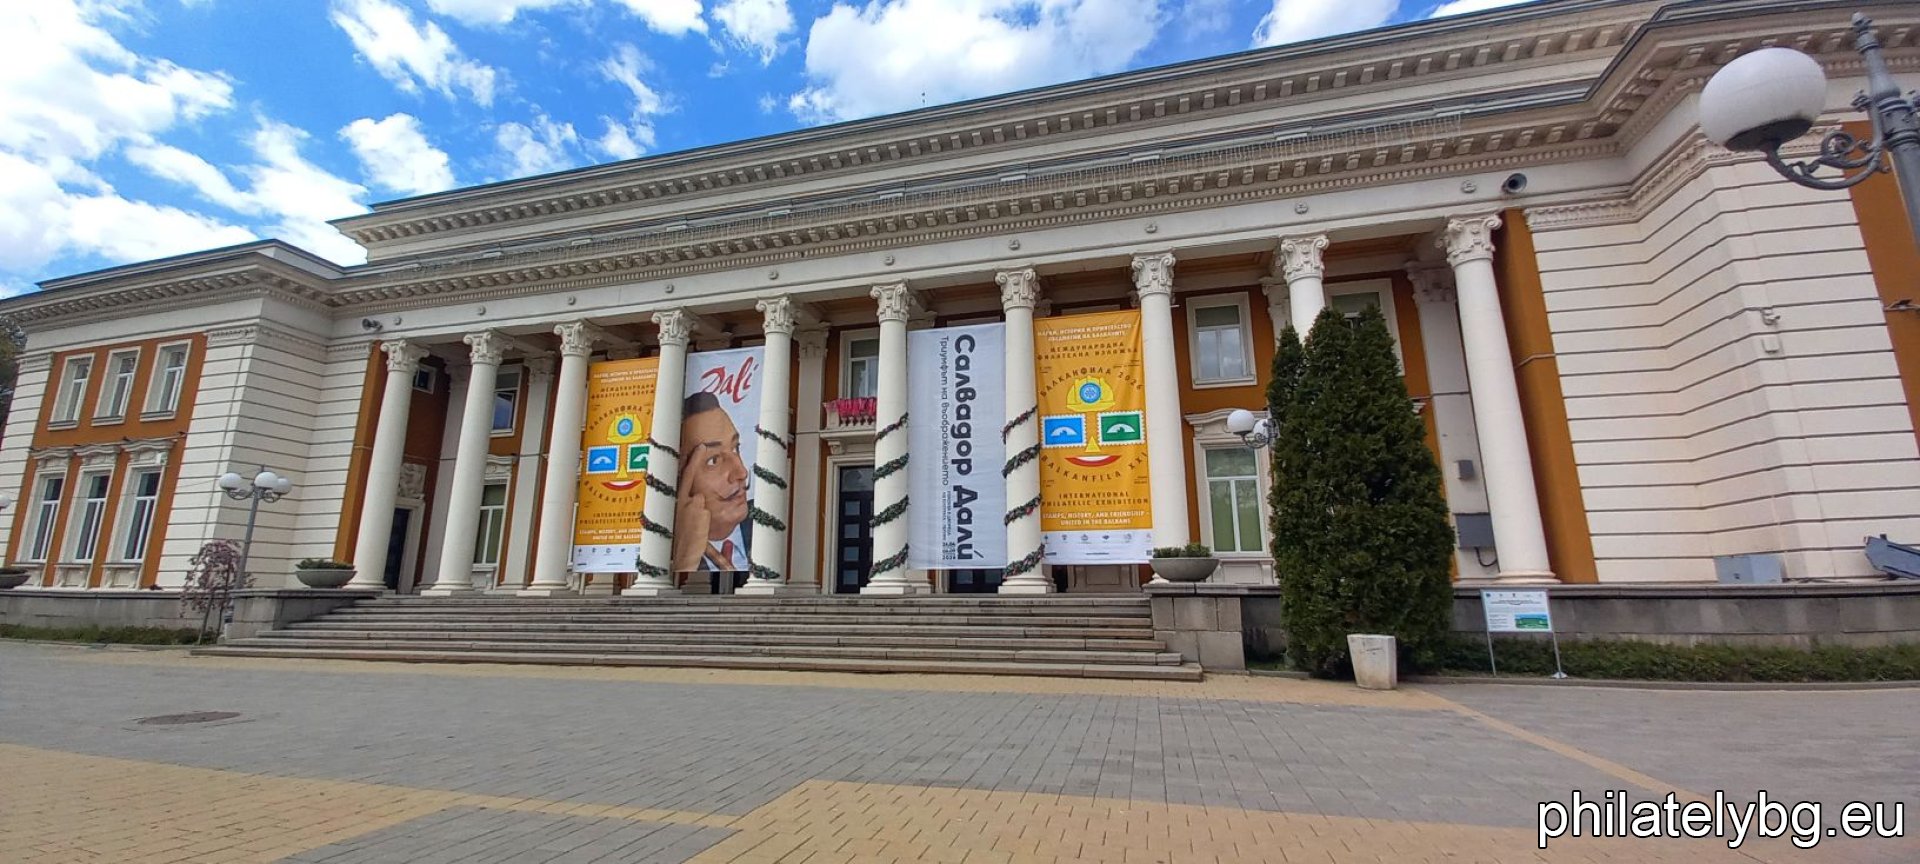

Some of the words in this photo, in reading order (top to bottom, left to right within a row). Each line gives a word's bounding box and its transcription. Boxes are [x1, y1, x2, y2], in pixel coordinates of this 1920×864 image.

[1037, 352, 1090, 360] ФИЛАТЕЛНА
[1050, 341, 1124, 353] МЕЖДУНАРОДНА
[940, 335, 949, 386] Триумфът
[1040, 366, 1112, 398] БАЛКАНФИЛА
[941, 387, 948, 400] на
[950, 334, 977, 475] Салвадор
[941, 402, 950, 486] въображението
[1040, 454, 1121, 483] BALKANFILA
[1128, 451, 1148, 470] XXI
[1041, 499, 1091, 507] PHILATELIC
[1096, 498, 1149, 506] EXHIBITION
[1059, 490, 1129, 499] INTERNATIONAL
